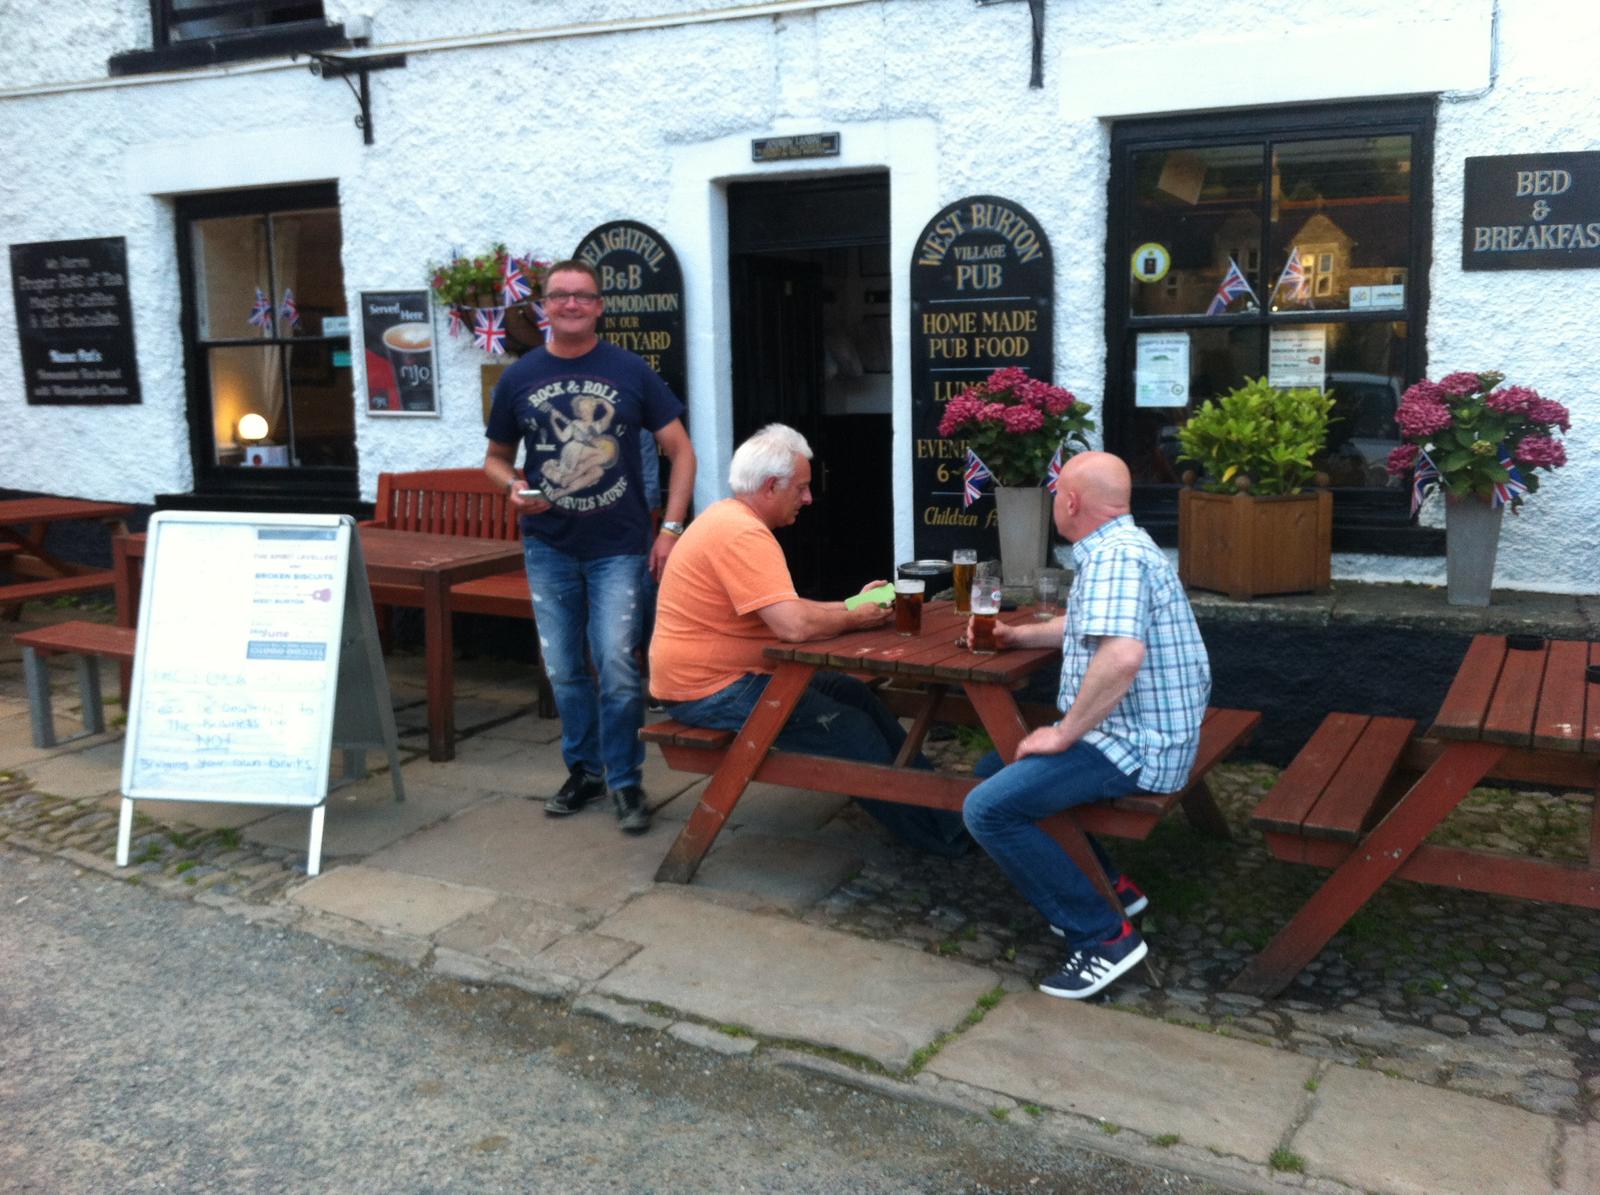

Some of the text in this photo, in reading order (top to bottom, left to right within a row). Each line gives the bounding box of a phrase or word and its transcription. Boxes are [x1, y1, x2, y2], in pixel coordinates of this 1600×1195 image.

[1516, 170, 1572, 197] BED
[1532, 199, 1551, 221] &
[919, 203, 1043, 267] WEST BURTON
[1473, 222, 1600, 252] BREAKFAS
[954, 244, 1006, 260] VILLAGE
[602, 264, 643, 290] B&B
[957, 263, 1002, 290] PUB
[369, 303, 424, 320] Served Here
[605, 316, 640, 328] IN OUR
[923, 310, 1038, 334] HOME MADE
[599, 331, 671, 350] RTYARD
[930, 336, 1030, 358] PUB FOOD
[528, 380, 619, 408] ROCK & ROLL
[924, 506, 978, 526] Children
